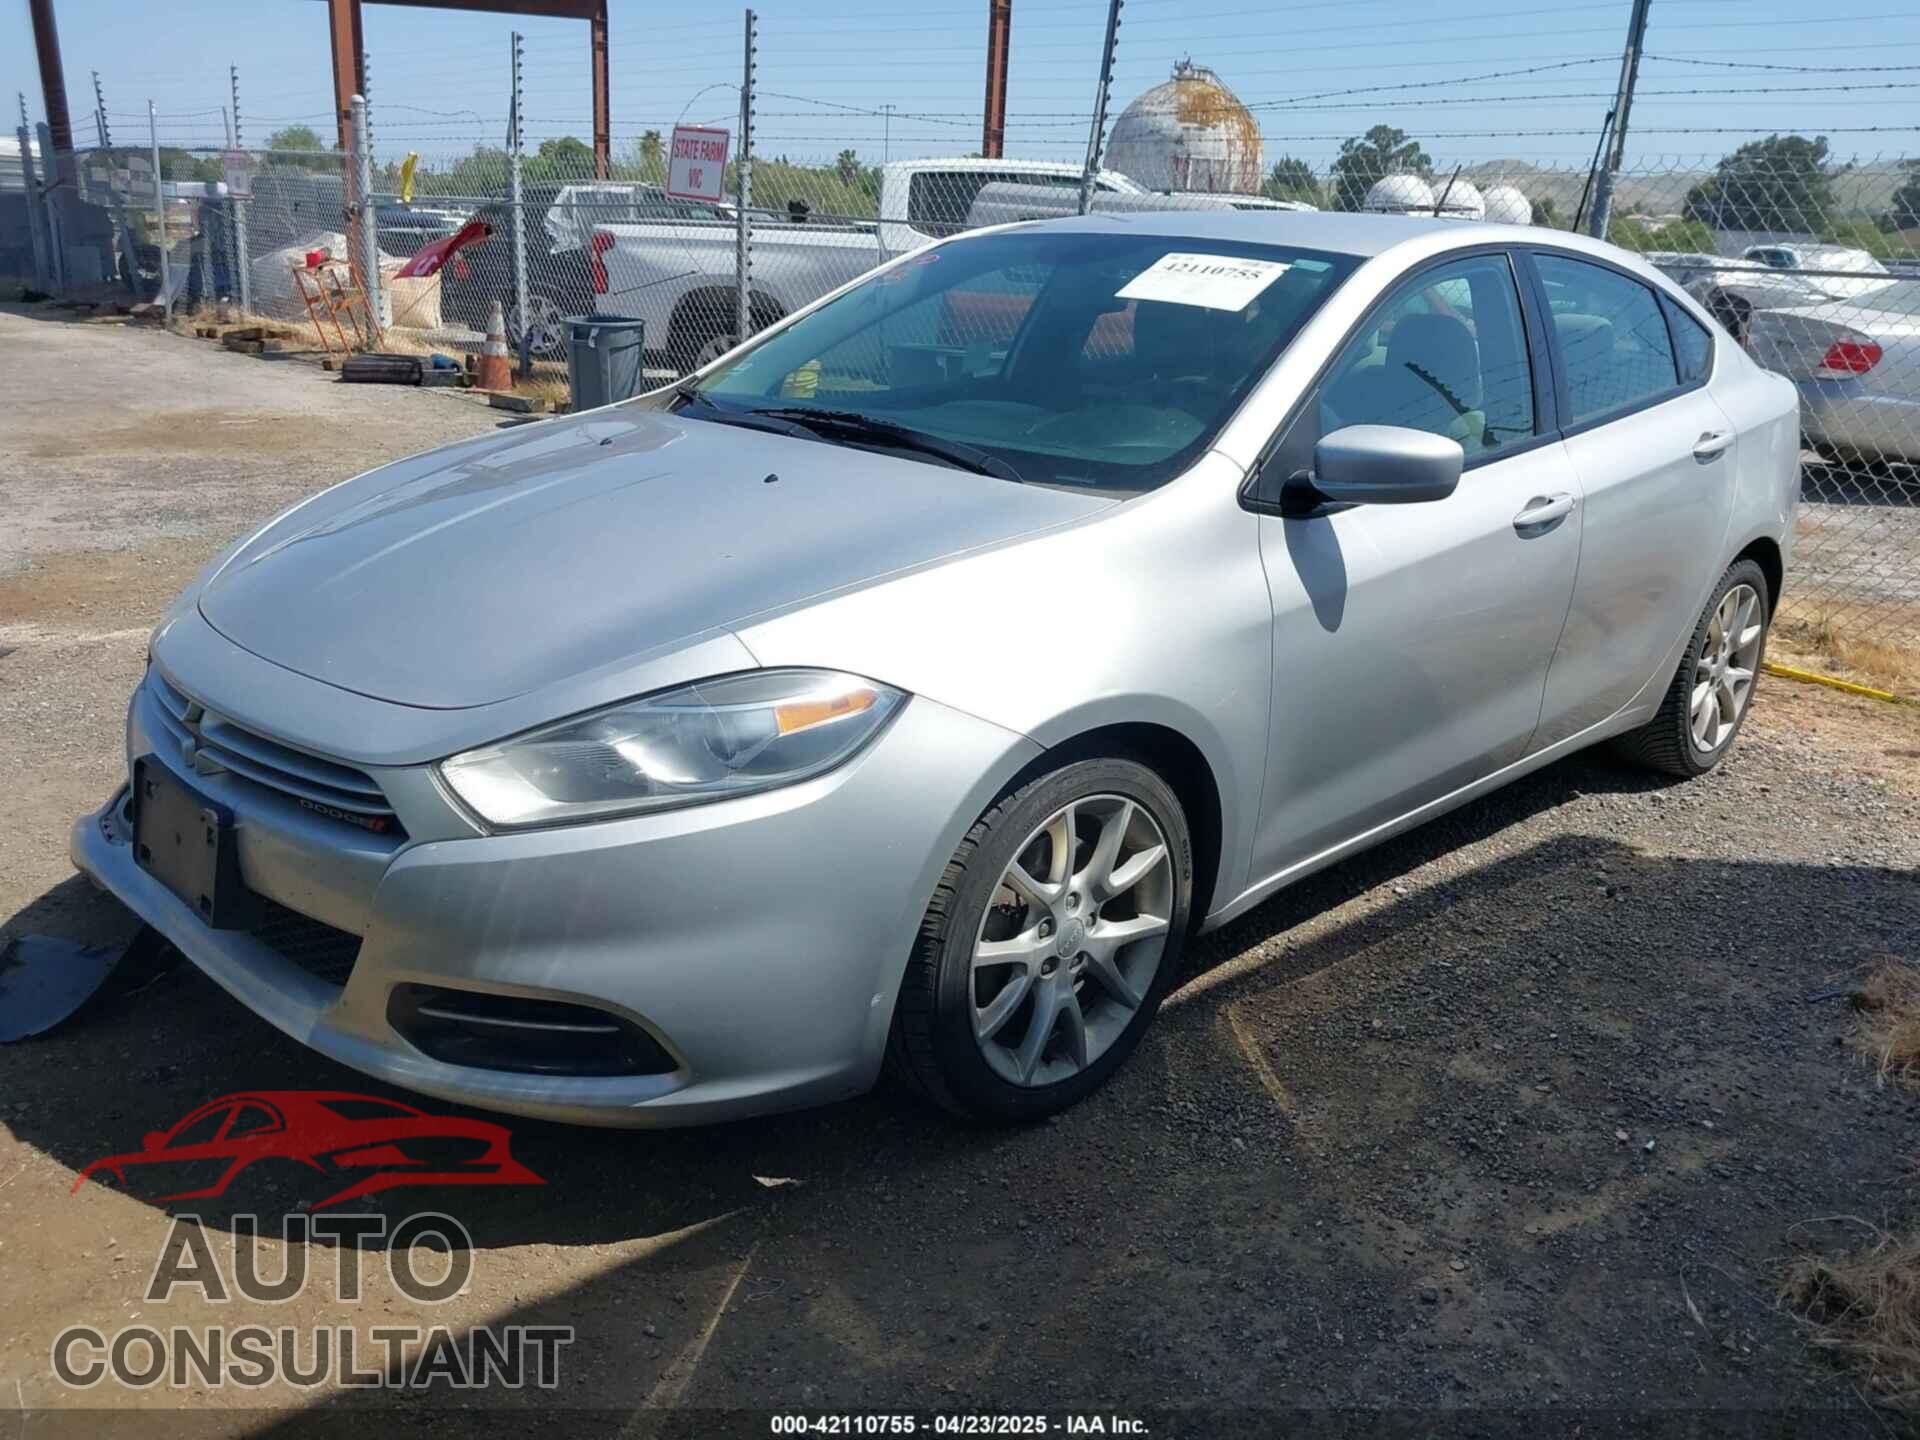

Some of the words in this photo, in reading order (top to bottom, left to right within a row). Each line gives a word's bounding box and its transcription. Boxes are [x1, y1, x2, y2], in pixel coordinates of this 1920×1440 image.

[673, 138, 699, 160] STATE
[701, 140, 725, 163] FARM
[688, 167, 704, 189] VIC
